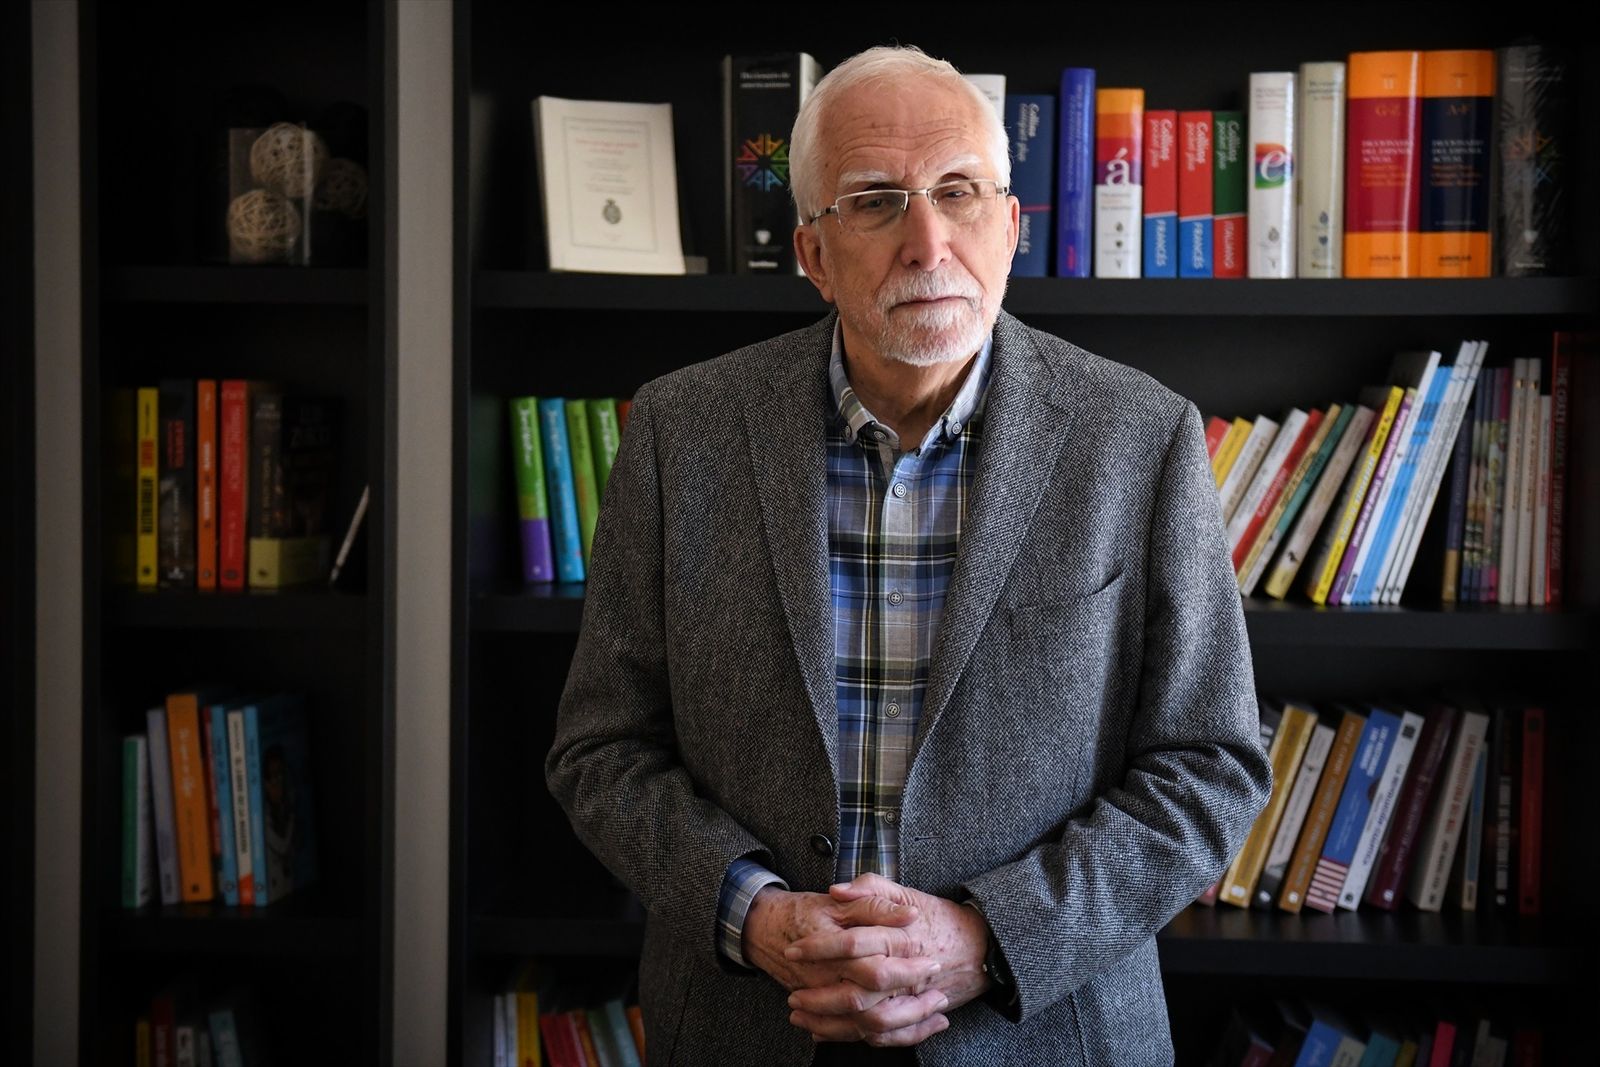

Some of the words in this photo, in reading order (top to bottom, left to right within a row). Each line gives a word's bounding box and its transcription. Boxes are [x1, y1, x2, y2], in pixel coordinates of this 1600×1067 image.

[1028, 103, 1040, 137] Collins
[1159, 118, 1173, 161] Collins
[1227, 120, 1241, 162] Collins
[1195, 121, 1209, 164] Collins
[1155, 219, 1168, 267] FRANCÉS
[1192, 222, 1205, 269] FRANCÉS
[1223, 220, 1235, 269] ITALIANO
